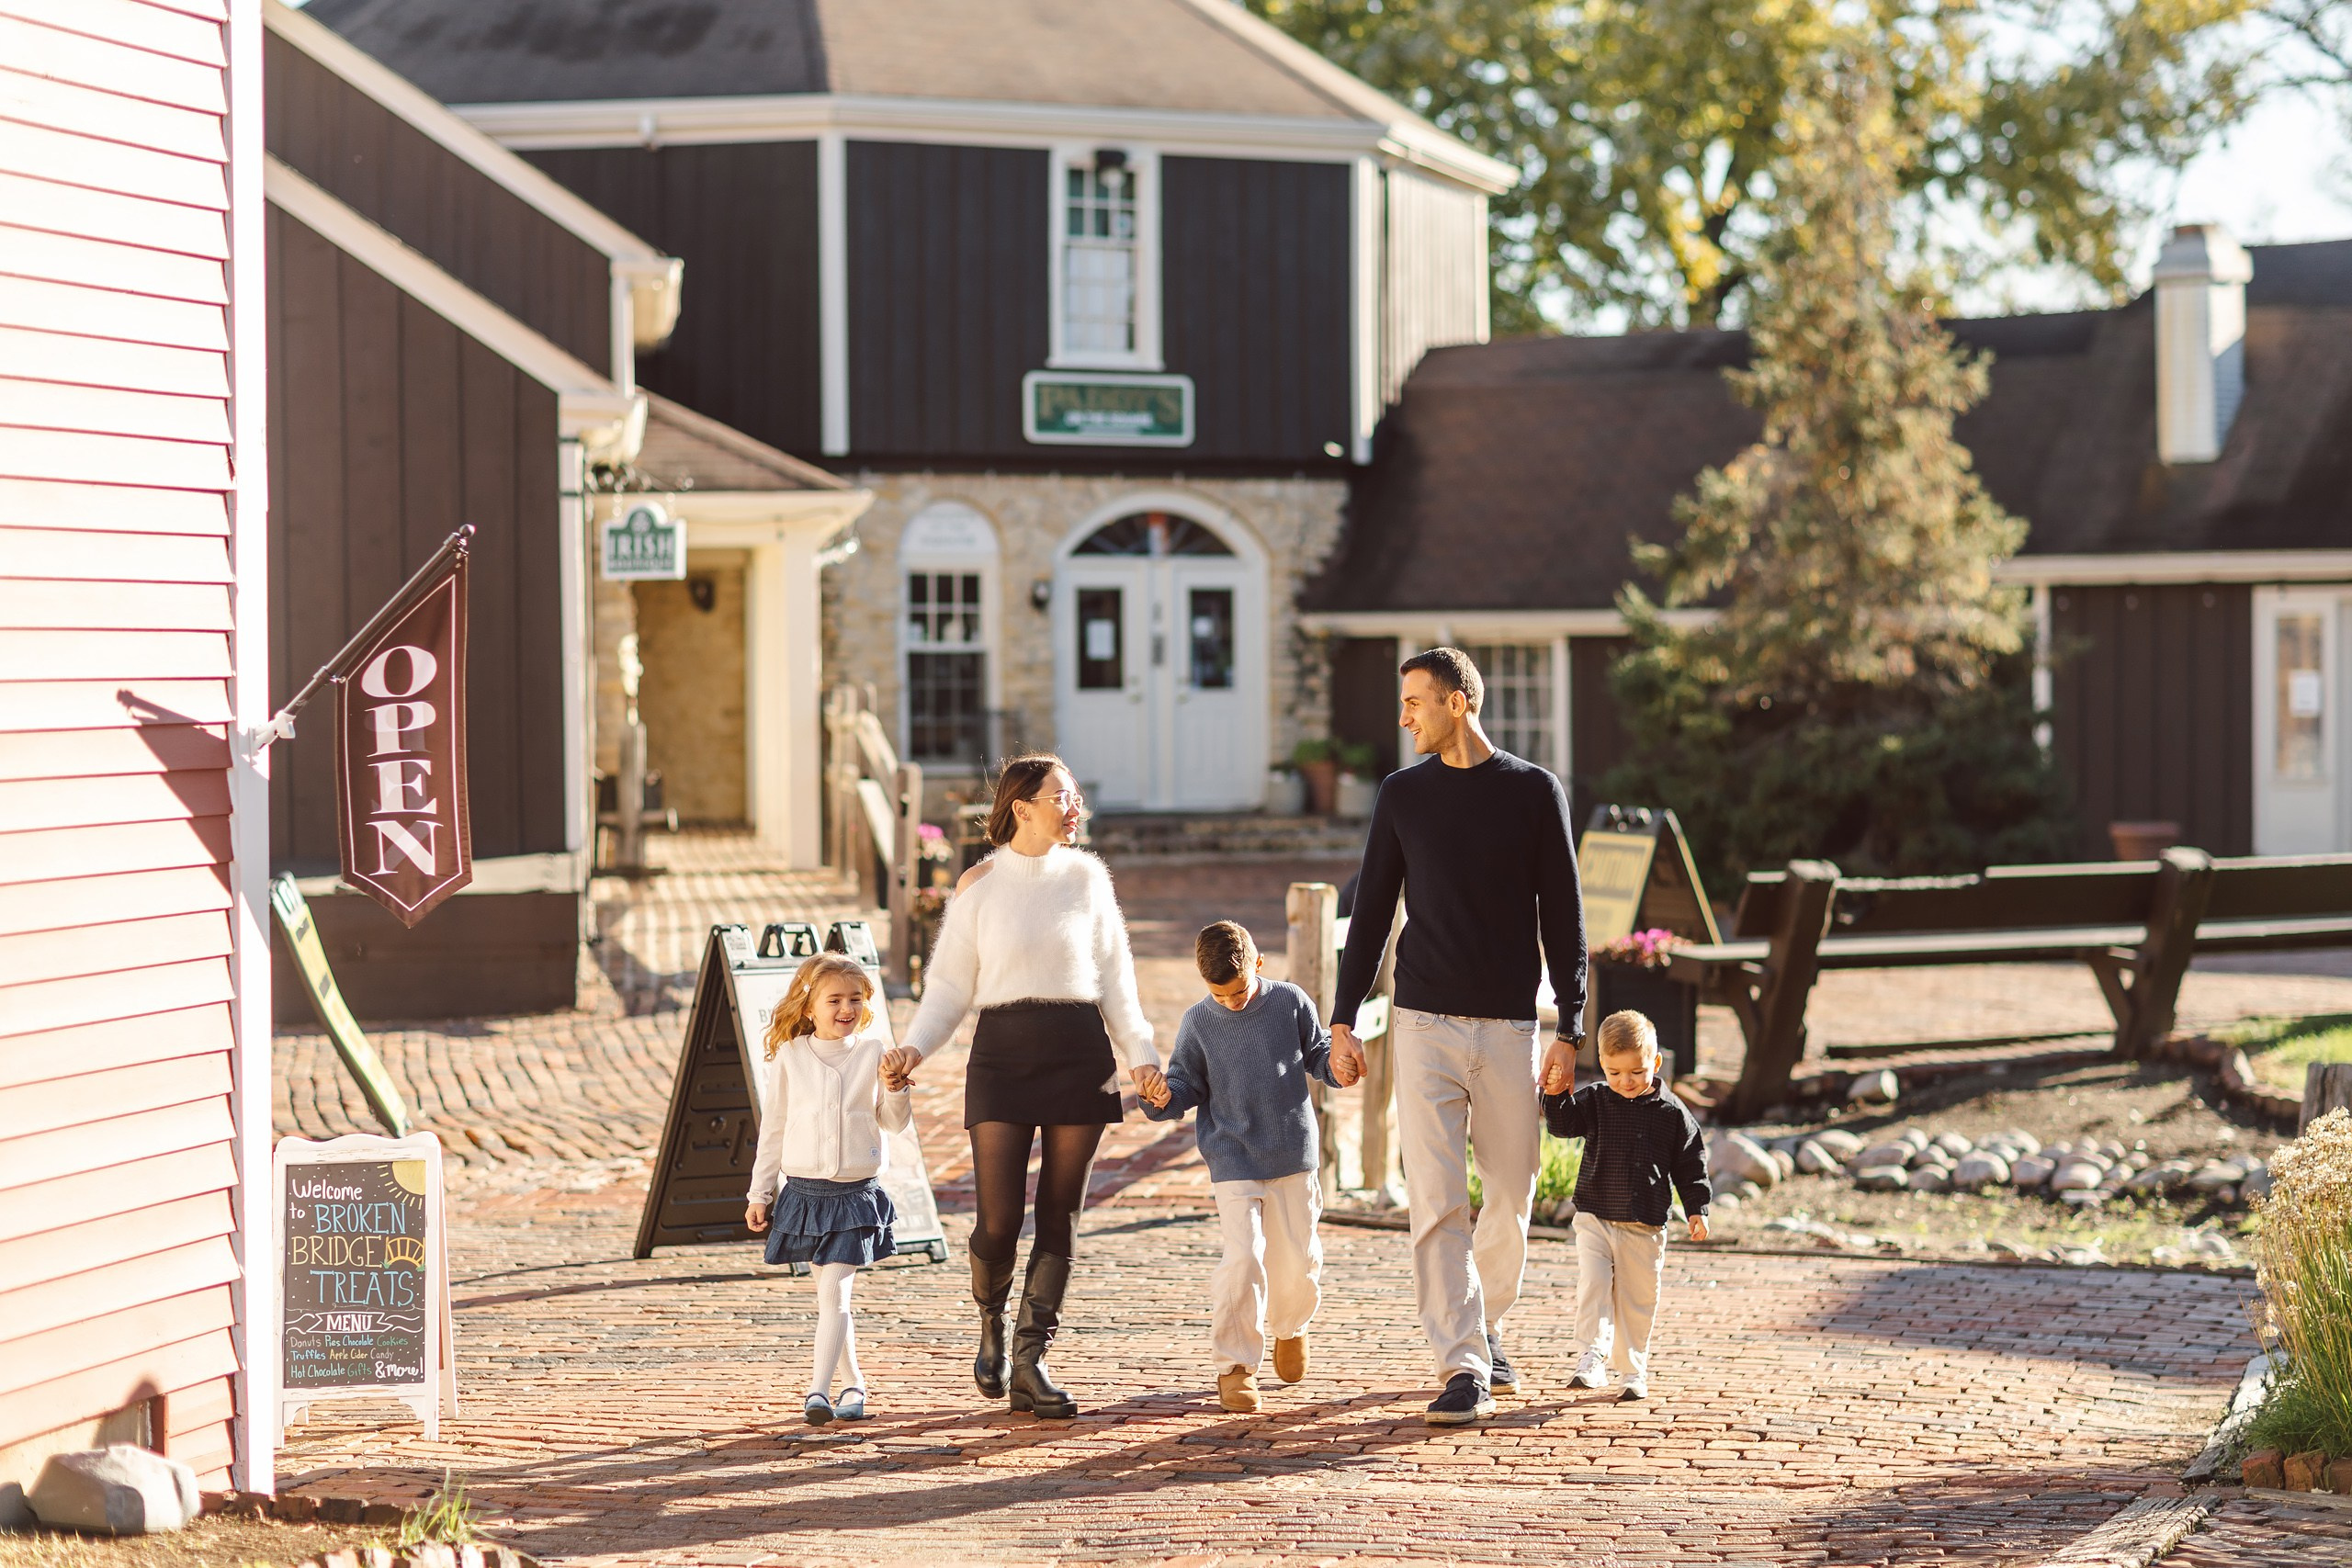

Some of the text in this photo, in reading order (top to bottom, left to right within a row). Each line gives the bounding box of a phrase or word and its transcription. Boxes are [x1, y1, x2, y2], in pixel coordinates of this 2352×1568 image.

[608, 533, 673, 558] IRISH
[360, 645, 445, 876] OPEN
[292, 1179, 363, 1201] Welcome
[289, 1201, 406, 1235] to BROKEN
[290, 1235, 382, 1268] BRIDGE
[310, 1269, 413, 1307] TREATS
[326, 1314, 372, 1331] MENU
[290, 1336, 322, 1348] Donuts
[324, 1335, 341, 1347] Pies
[342, 1334, 374, 1347] Chocolate
[290, 1348, 394, 1361] Truffles Apple Cider Candy
[290, 1365, 306, 1379] Hot
[307, 1363, 345, 1378] Chocolate
[347, 1362, 373, 1377] Gifts
